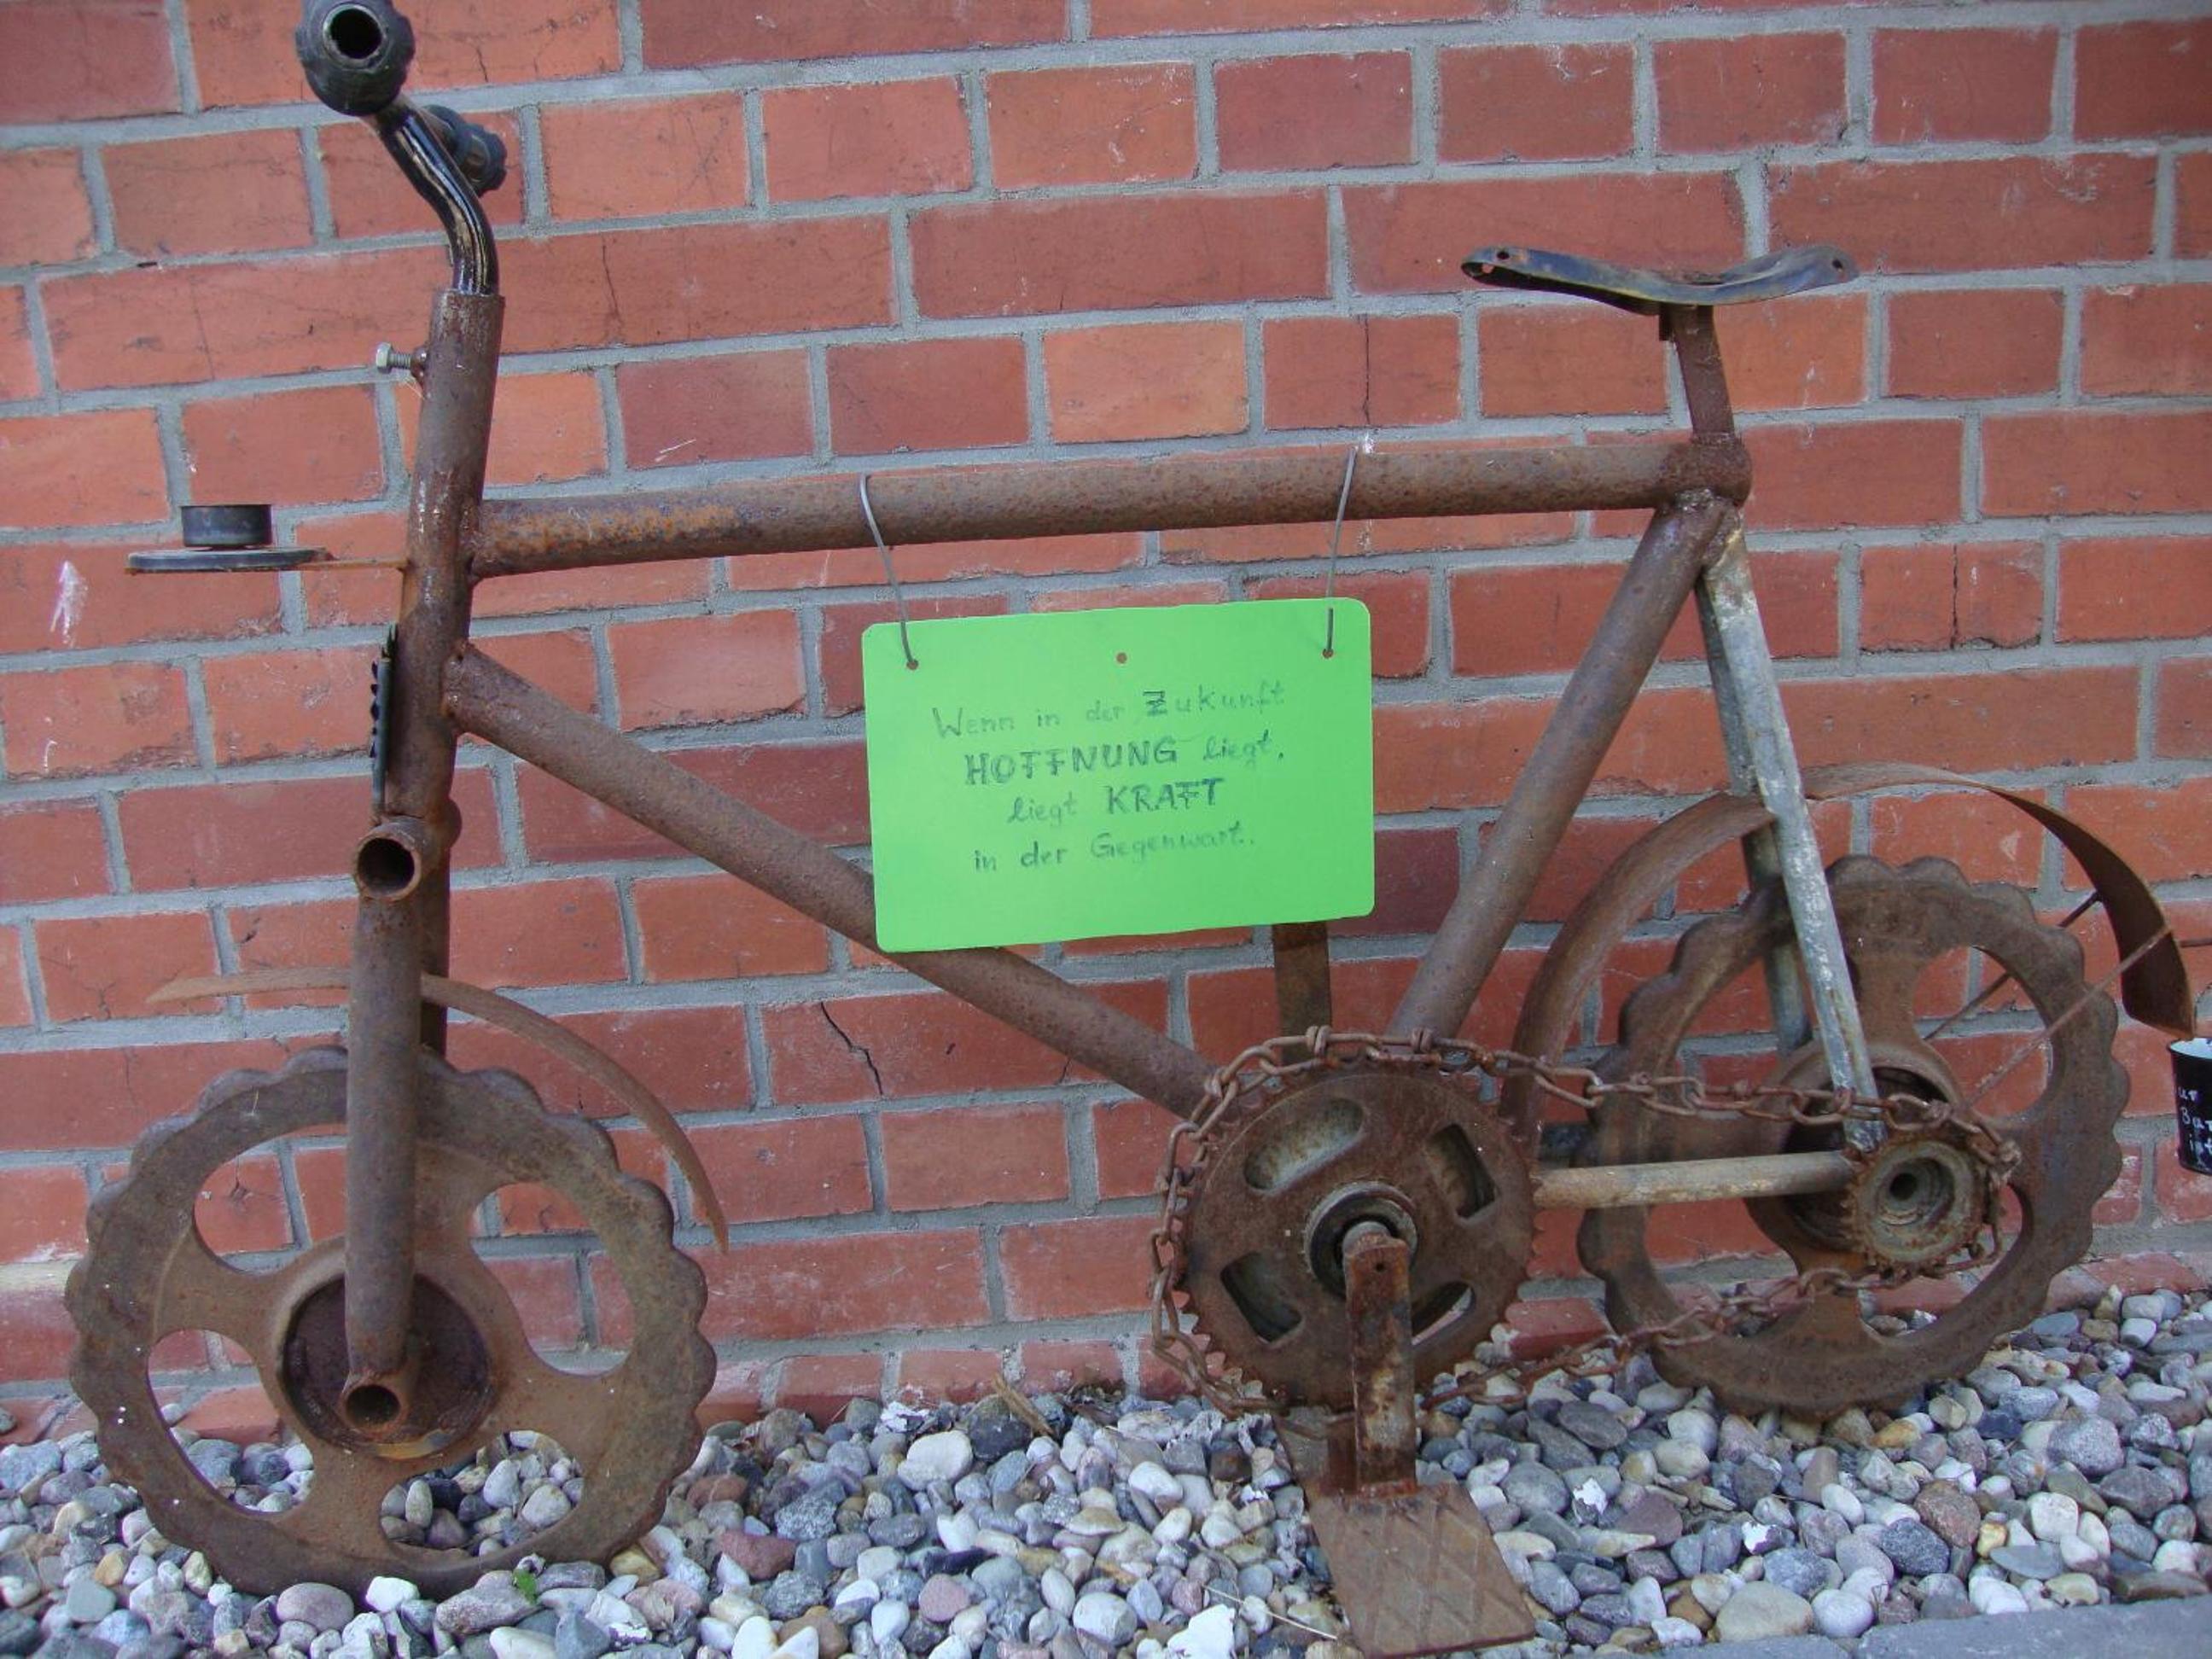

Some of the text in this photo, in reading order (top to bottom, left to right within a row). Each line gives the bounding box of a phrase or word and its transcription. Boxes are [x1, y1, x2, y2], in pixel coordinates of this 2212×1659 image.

[932, 680, 1284, 737] Wenn in der Zukunft
[1007, 777, 1224, 826] liegt KRAFT
[975, 850, 996, 871] in
[1020, 841, 1067, 867] der
